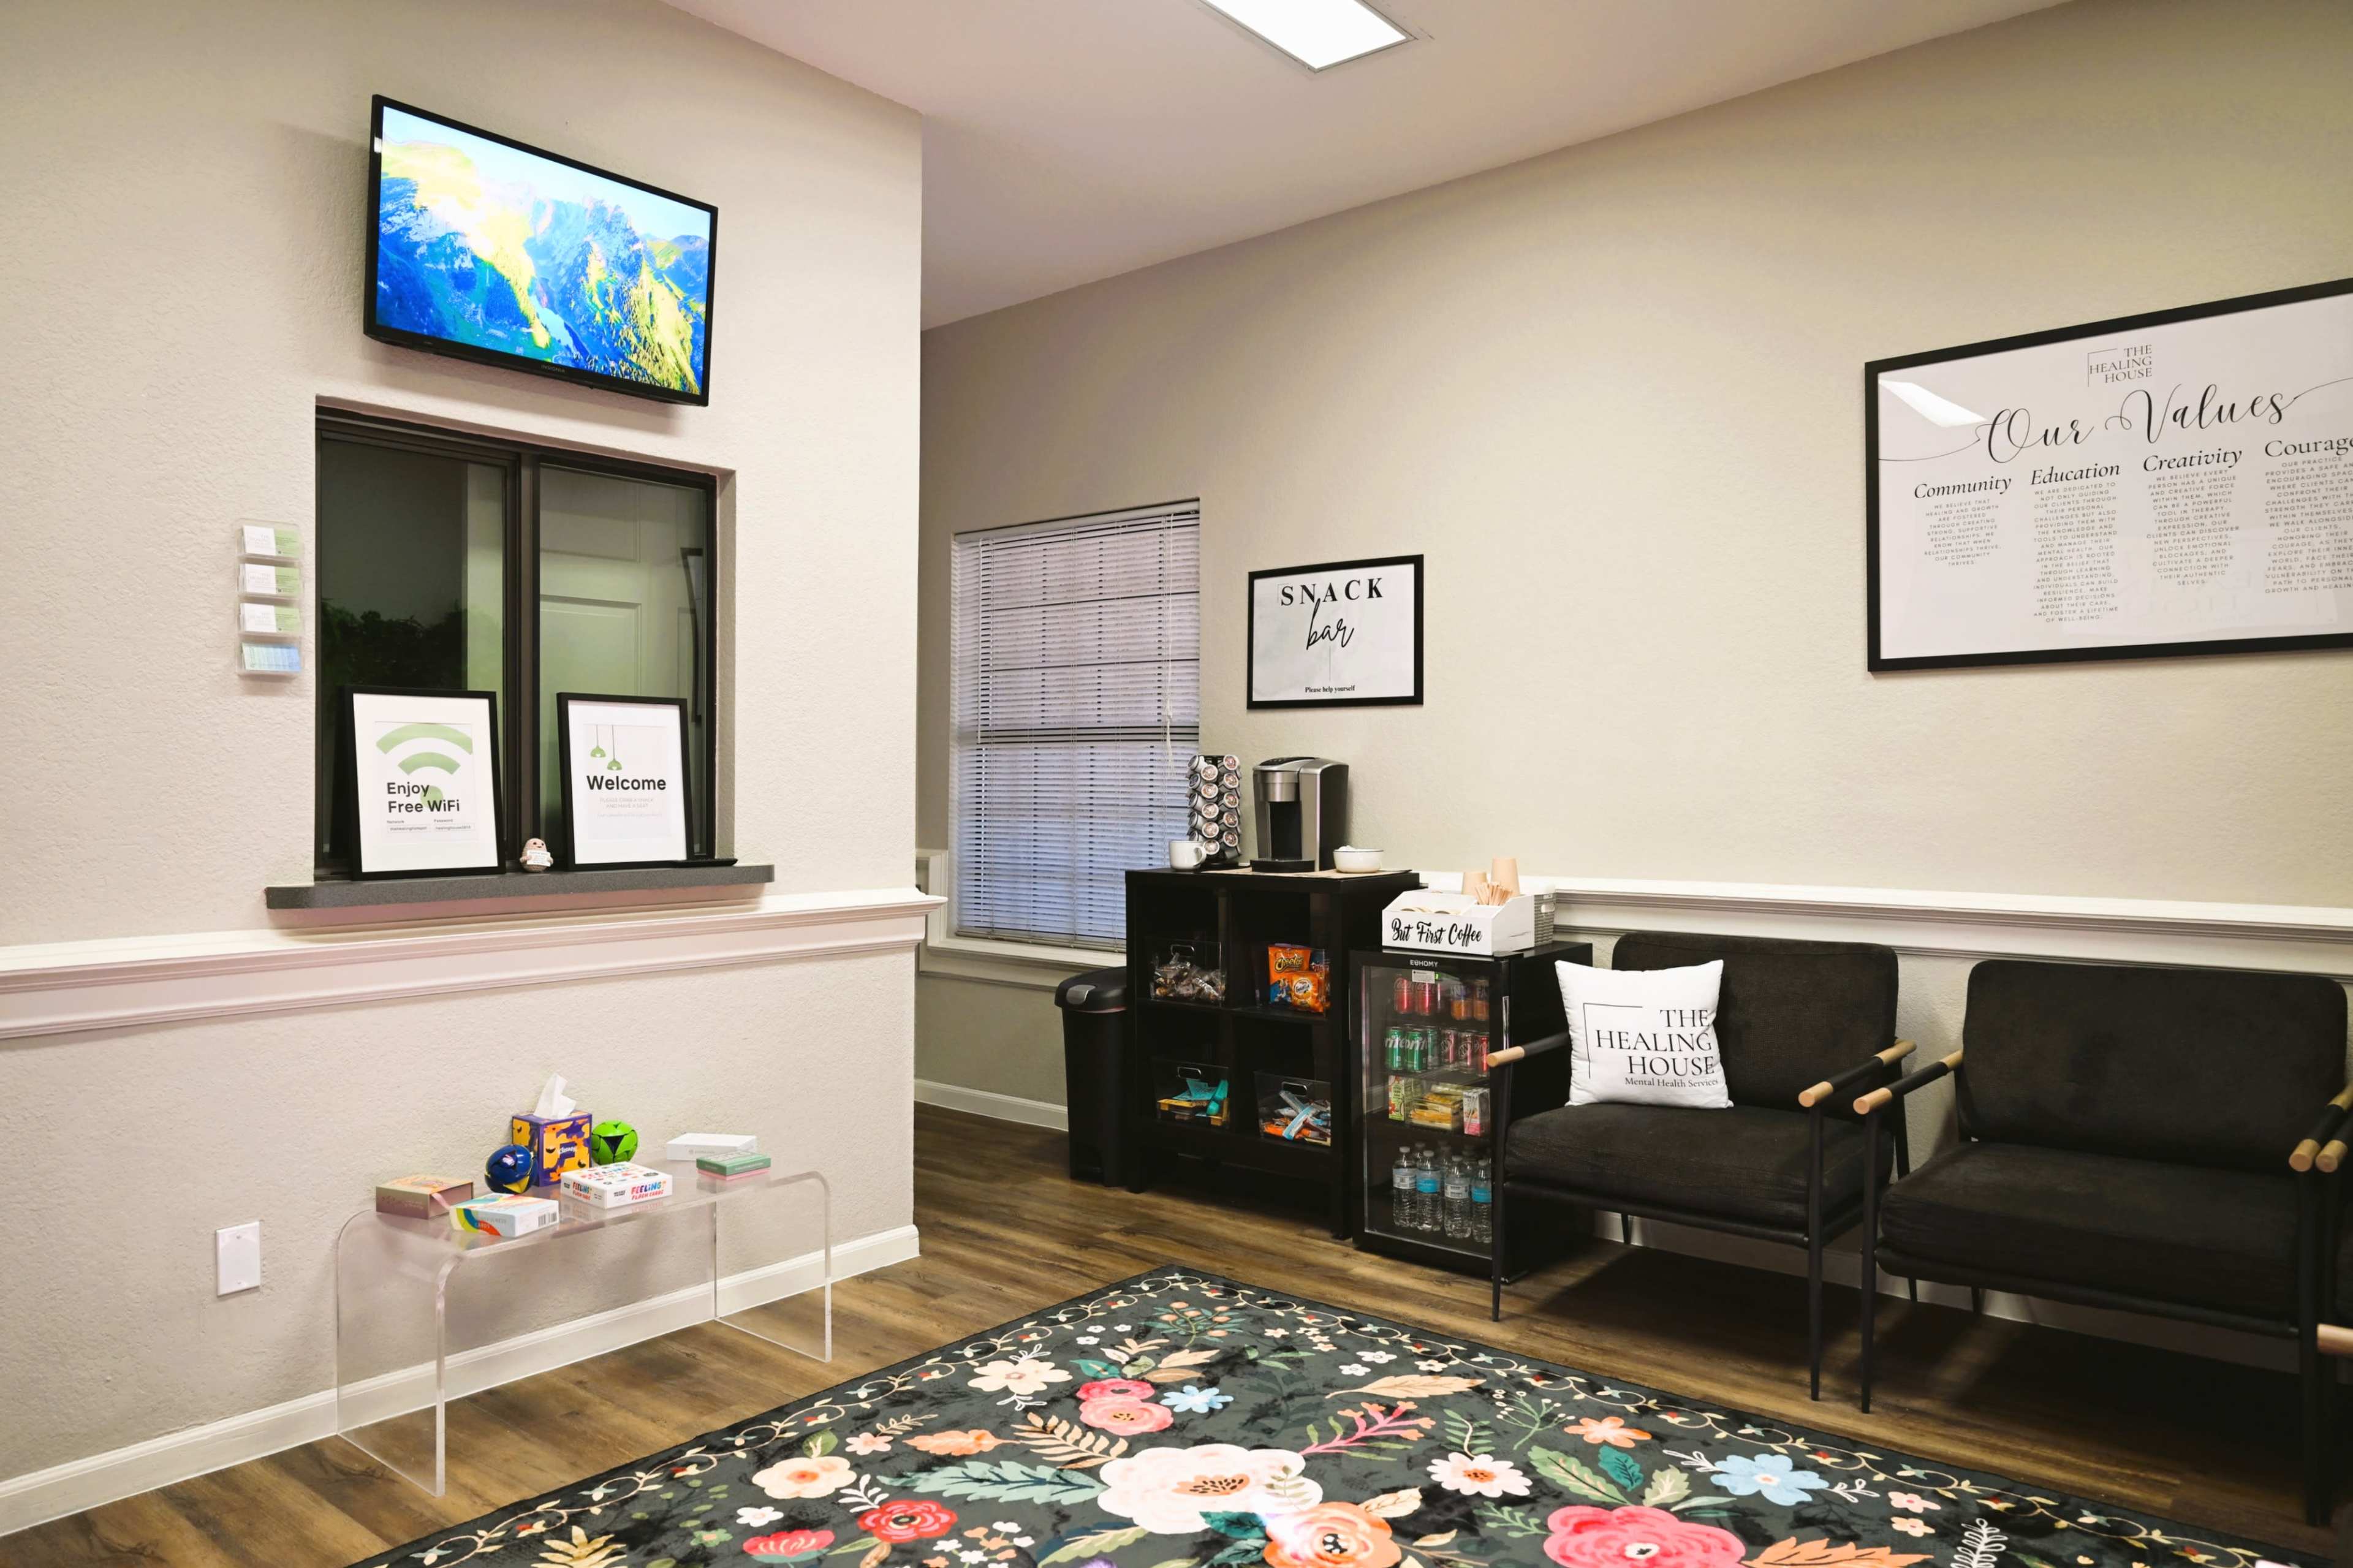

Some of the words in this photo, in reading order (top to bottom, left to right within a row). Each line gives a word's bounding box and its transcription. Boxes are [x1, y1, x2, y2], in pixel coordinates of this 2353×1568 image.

[2124, 344, 2152, 357] THE
[2089, 355, 2153, 376] HEALING
[2104, 368, 2153, 385] HOUSE
[1978, 408, 2093, 464] Our
[2105, 384, 2287, 444] Values
[1914, 475, 2012, 499] Community
[2031, 463, 2120, 486] Education
[2143, 447, 2242, 472] Creativity
[2309, 515, 2353, 524] ALONGSID
[1281, 578, 1382, 606] SNACK
[1306, 598, 1354, 650] bar
[1334, 685, 1355, 694] yourself
[387, 782, 430, 798] Enjoy
[586, 775, 666, 790] Welcome
[388, 800, 423, 814] Free
[427, 799, 460, 812] WiFi
[1392, 918, 1413, 941] But
[1417, 921, 1446, 944] First
[1448, 923, 1482, 947] Coffee
[1660, 1009, 1710, 1027] THE
[1595, 1029, 1712, 1052] HEALING
[1627, 1056, 1715, 1077] HOUSE
[1625, 1077, 1655, 1086] Mental
[1657, 1078, 1686, 1088] Health
